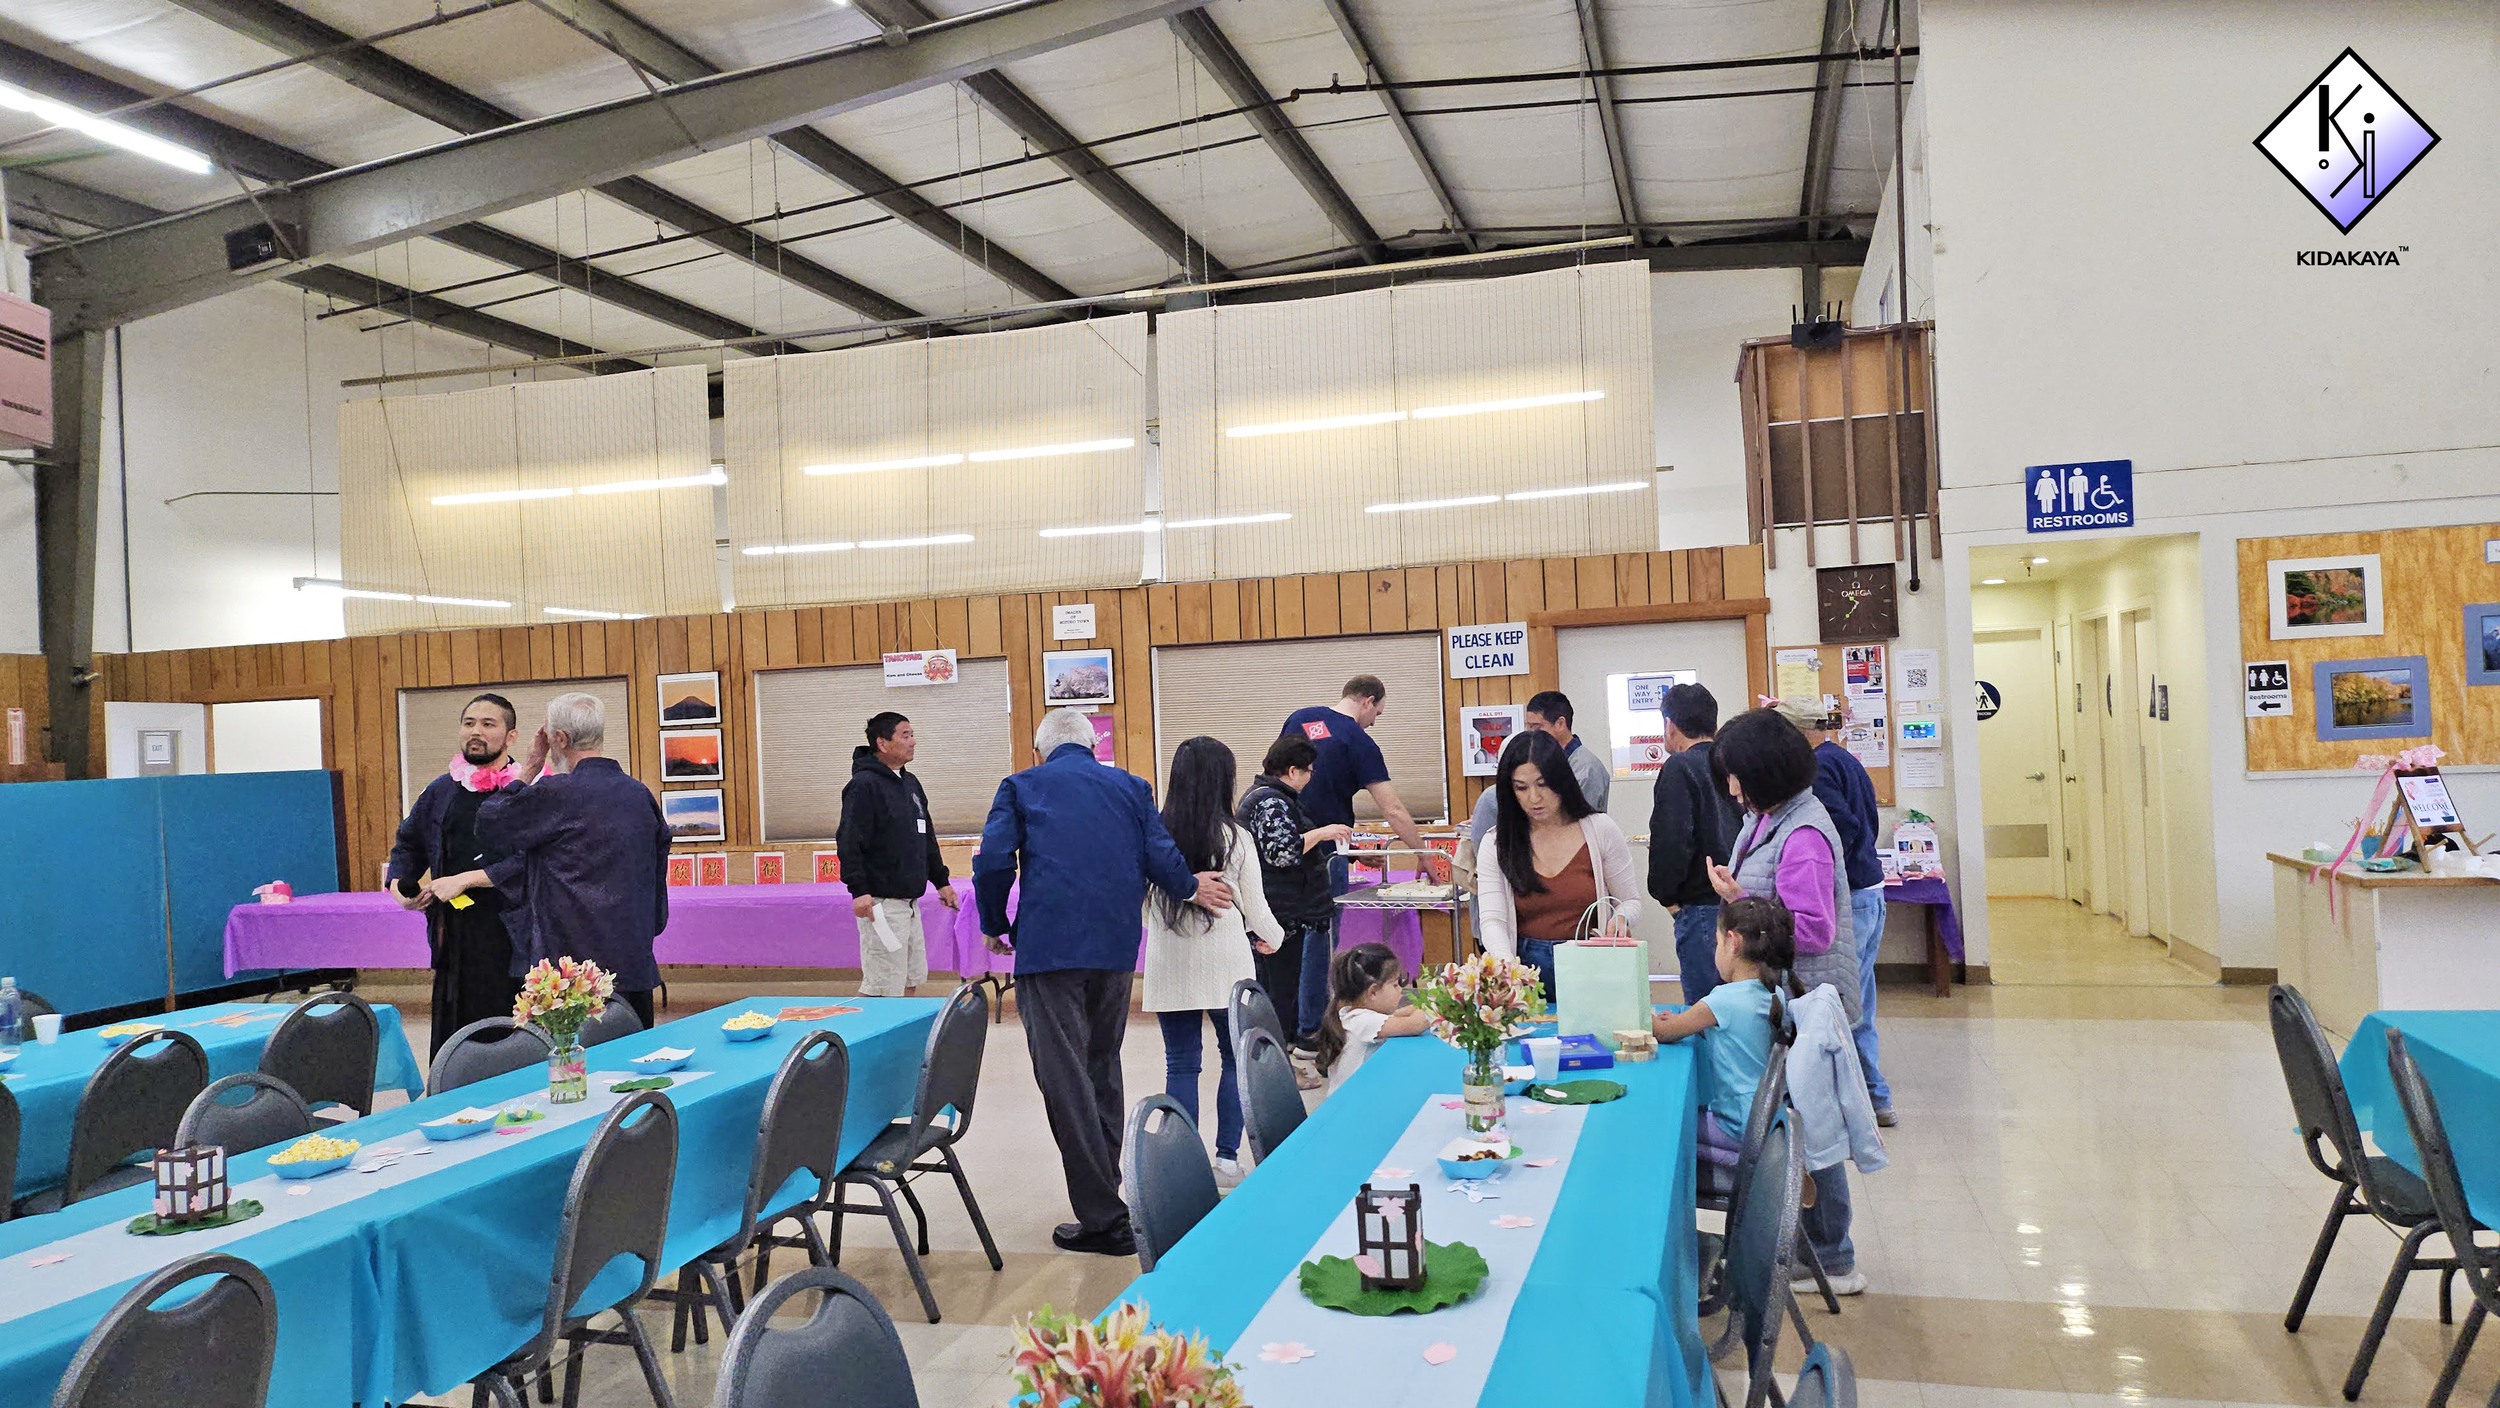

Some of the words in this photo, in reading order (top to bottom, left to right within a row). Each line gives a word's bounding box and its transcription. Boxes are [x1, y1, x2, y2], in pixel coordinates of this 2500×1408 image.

[2033, 512, 2128, 528] RESTROOMS
[1452, 633, 1492, 649] PLEASE
[1495, 631, 1523, 646] KEEP
[884, 653, 922, 663] TAKOYAKI
[1465, 653, 1514, 669] CLEAN
[2412, 802, 2450, 812] WELCOME
